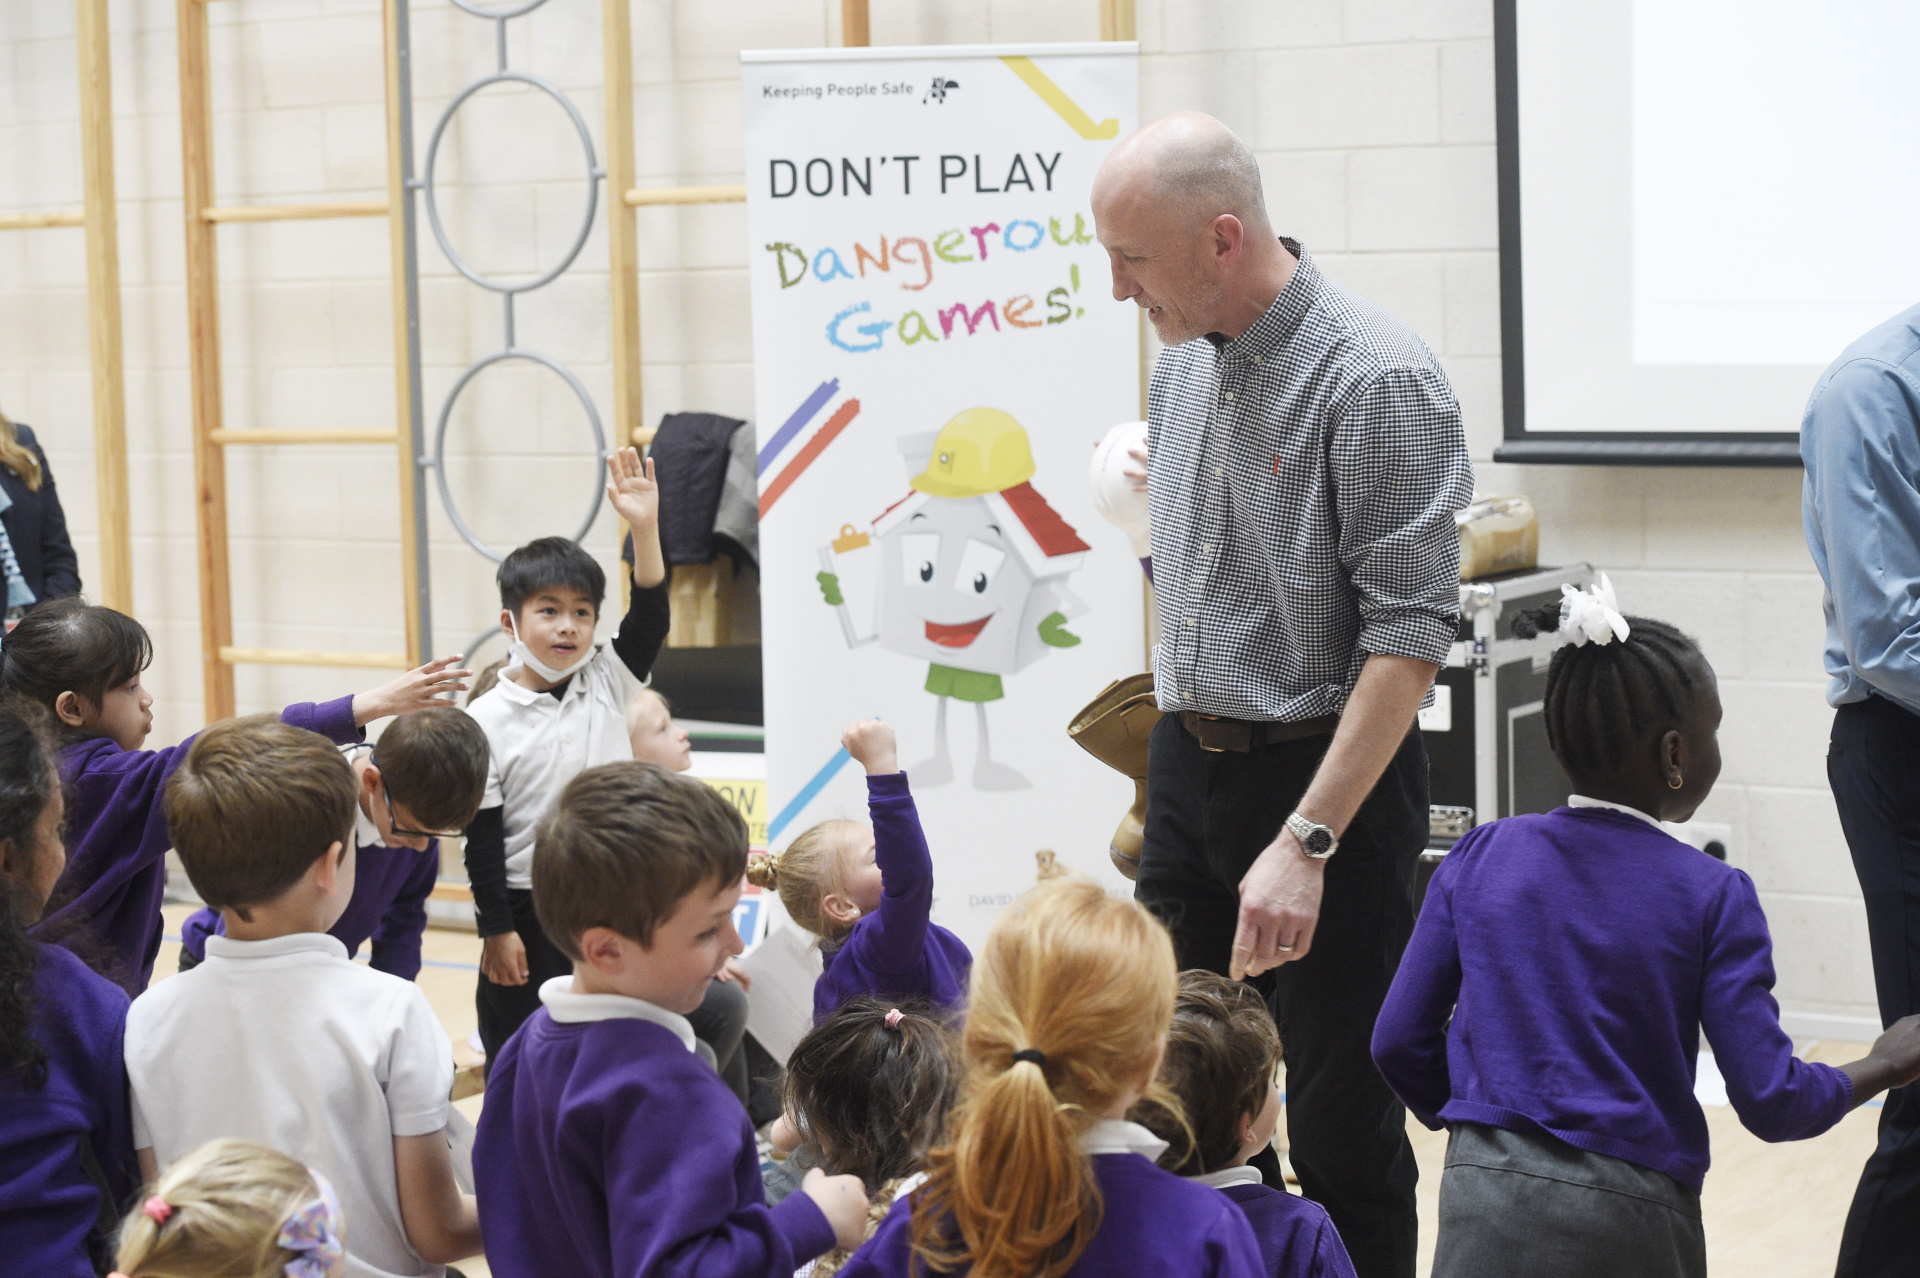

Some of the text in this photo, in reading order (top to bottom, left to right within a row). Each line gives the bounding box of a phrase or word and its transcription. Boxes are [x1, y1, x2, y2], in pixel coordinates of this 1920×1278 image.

[763, 82, 914, 99] Keeping People Safe
[769, 152, 1062, 198] DON'T PLAY
[765, 213, 1094, 291] Dangerou
[825, 263, 1085, 353] Games!
